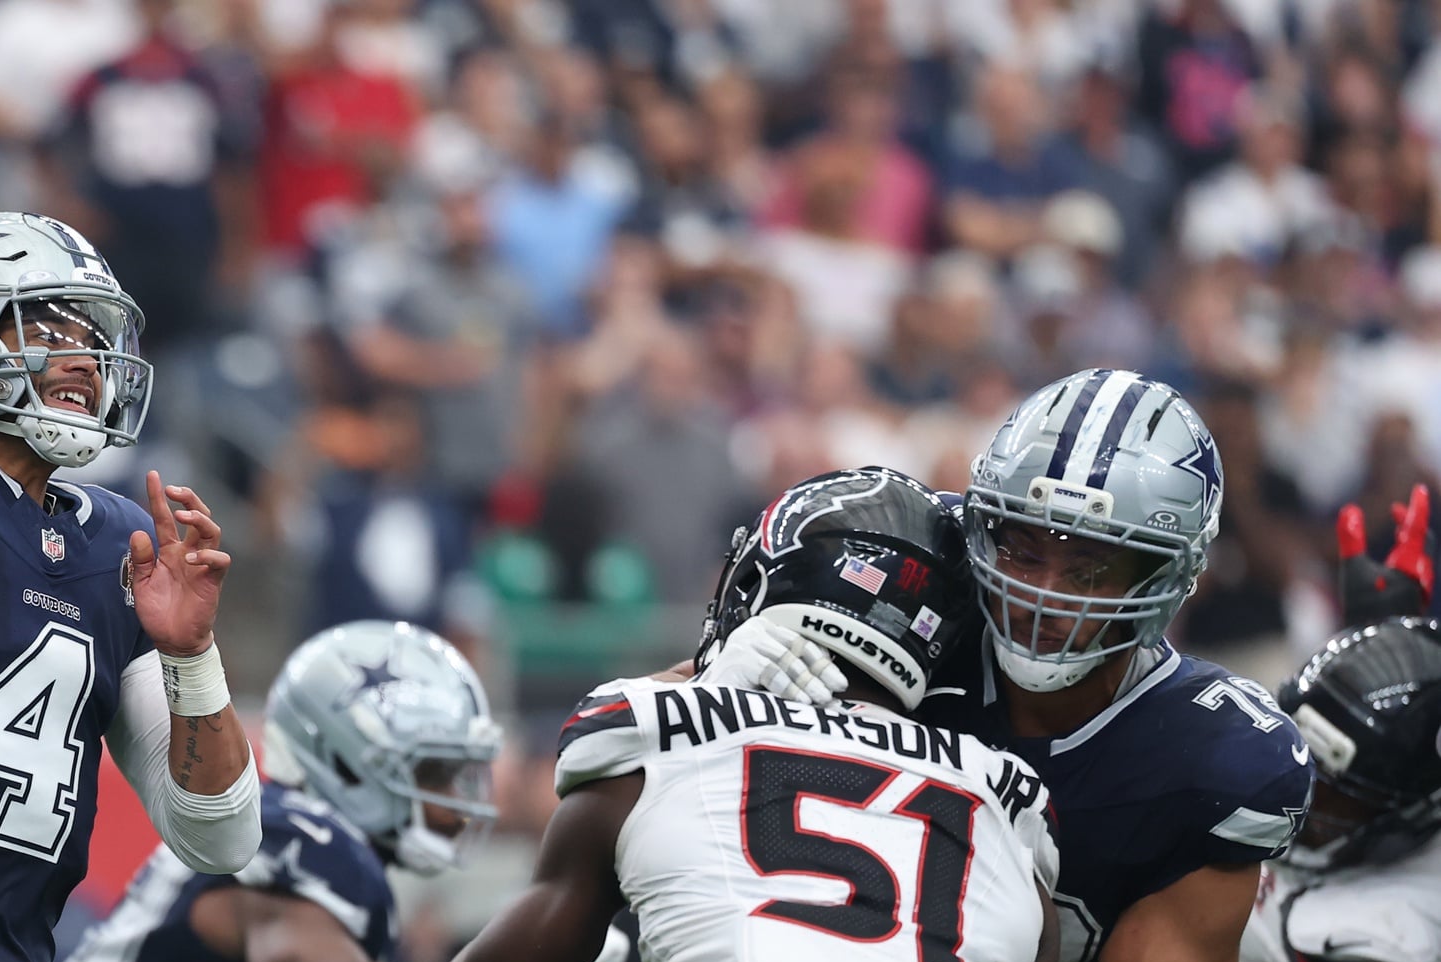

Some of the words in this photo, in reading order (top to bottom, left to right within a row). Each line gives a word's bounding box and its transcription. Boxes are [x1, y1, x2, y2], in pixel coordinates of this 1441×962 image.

[46, 540, 63, 558] NFL
[22, 588, 81, 621] COWBOYS
[801, 615, 918, 689] HOUSTON
[655, 686, 962, 771] ANDERSON
[986, 758, 1042, 832] JR
